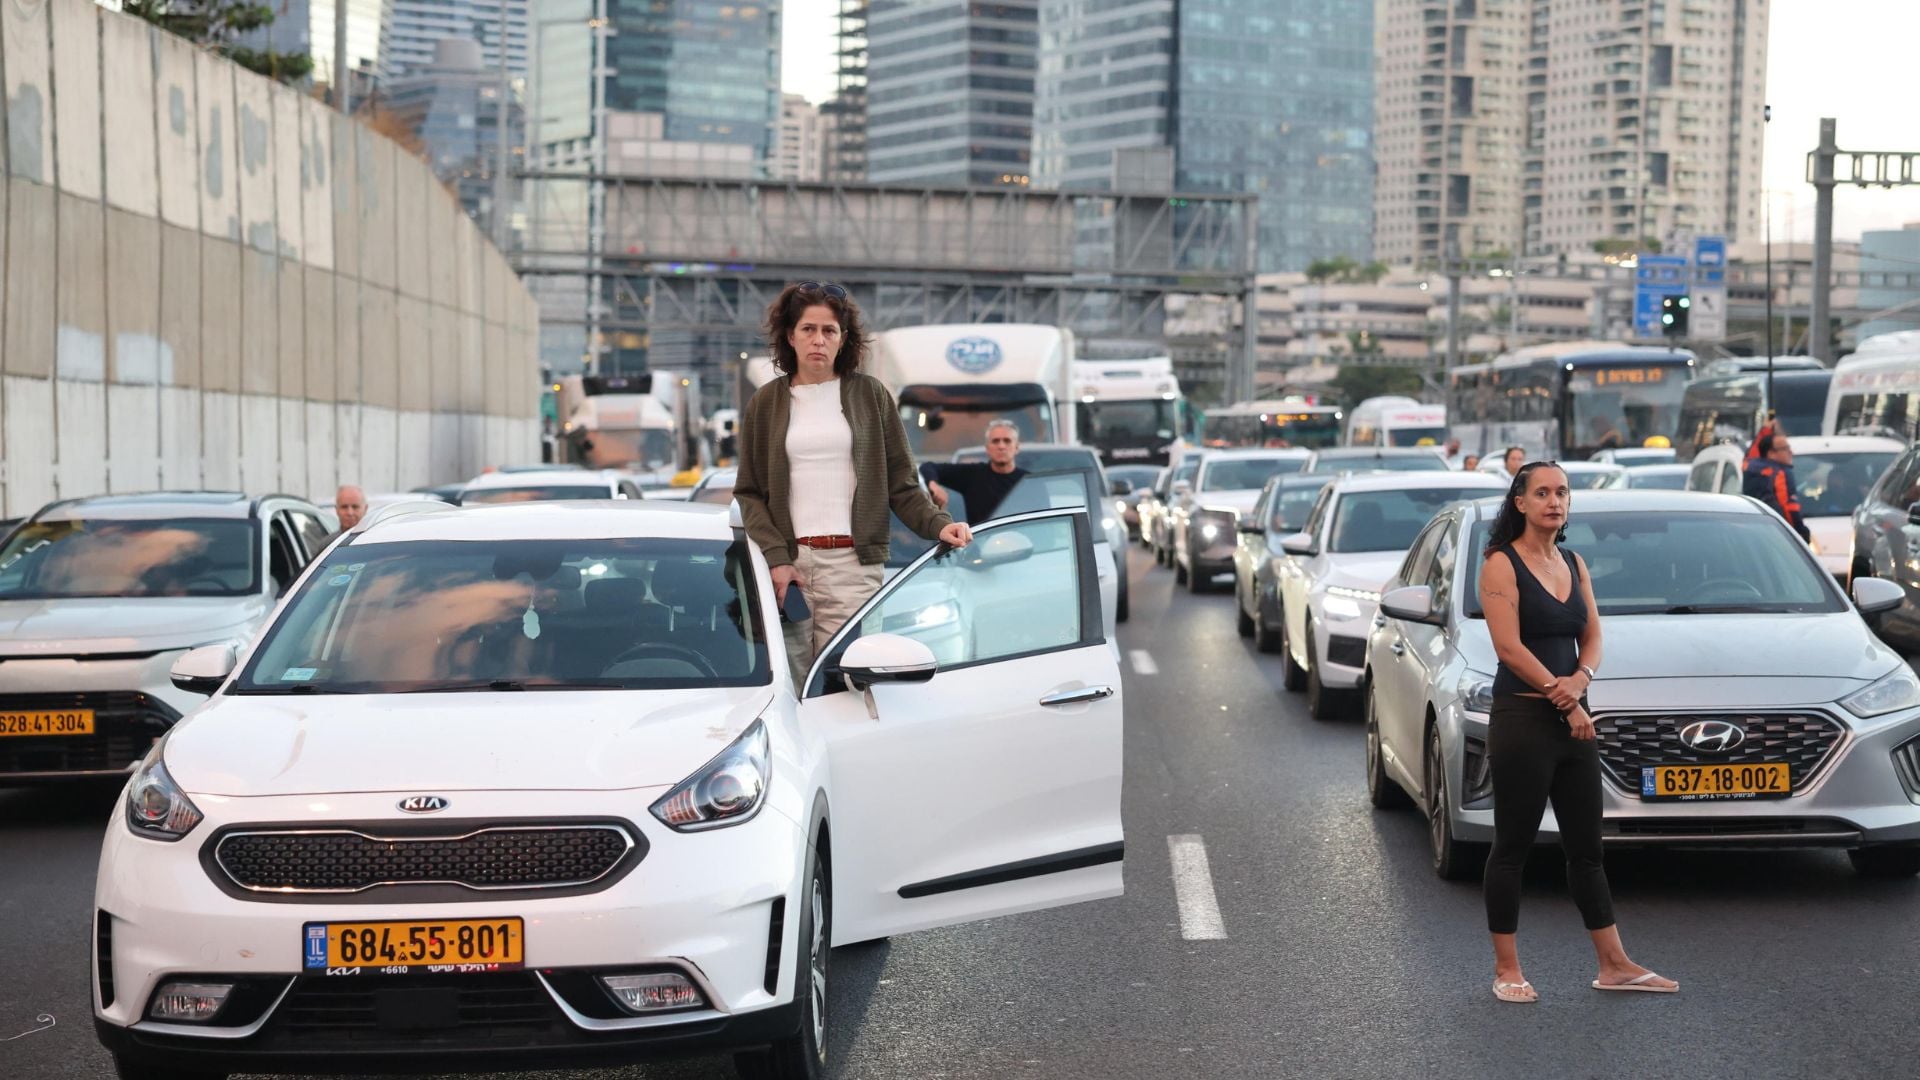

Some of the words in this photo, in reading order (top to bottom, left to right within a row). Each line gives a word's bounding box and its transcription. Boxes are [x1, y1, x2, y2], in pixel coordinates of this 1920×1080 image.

[405, 797, 441, 809] KIA
[311, 938, 324, 956] IL
[326, 967, 360, 976] KIA
[427, 964, 454, 973] שישי
